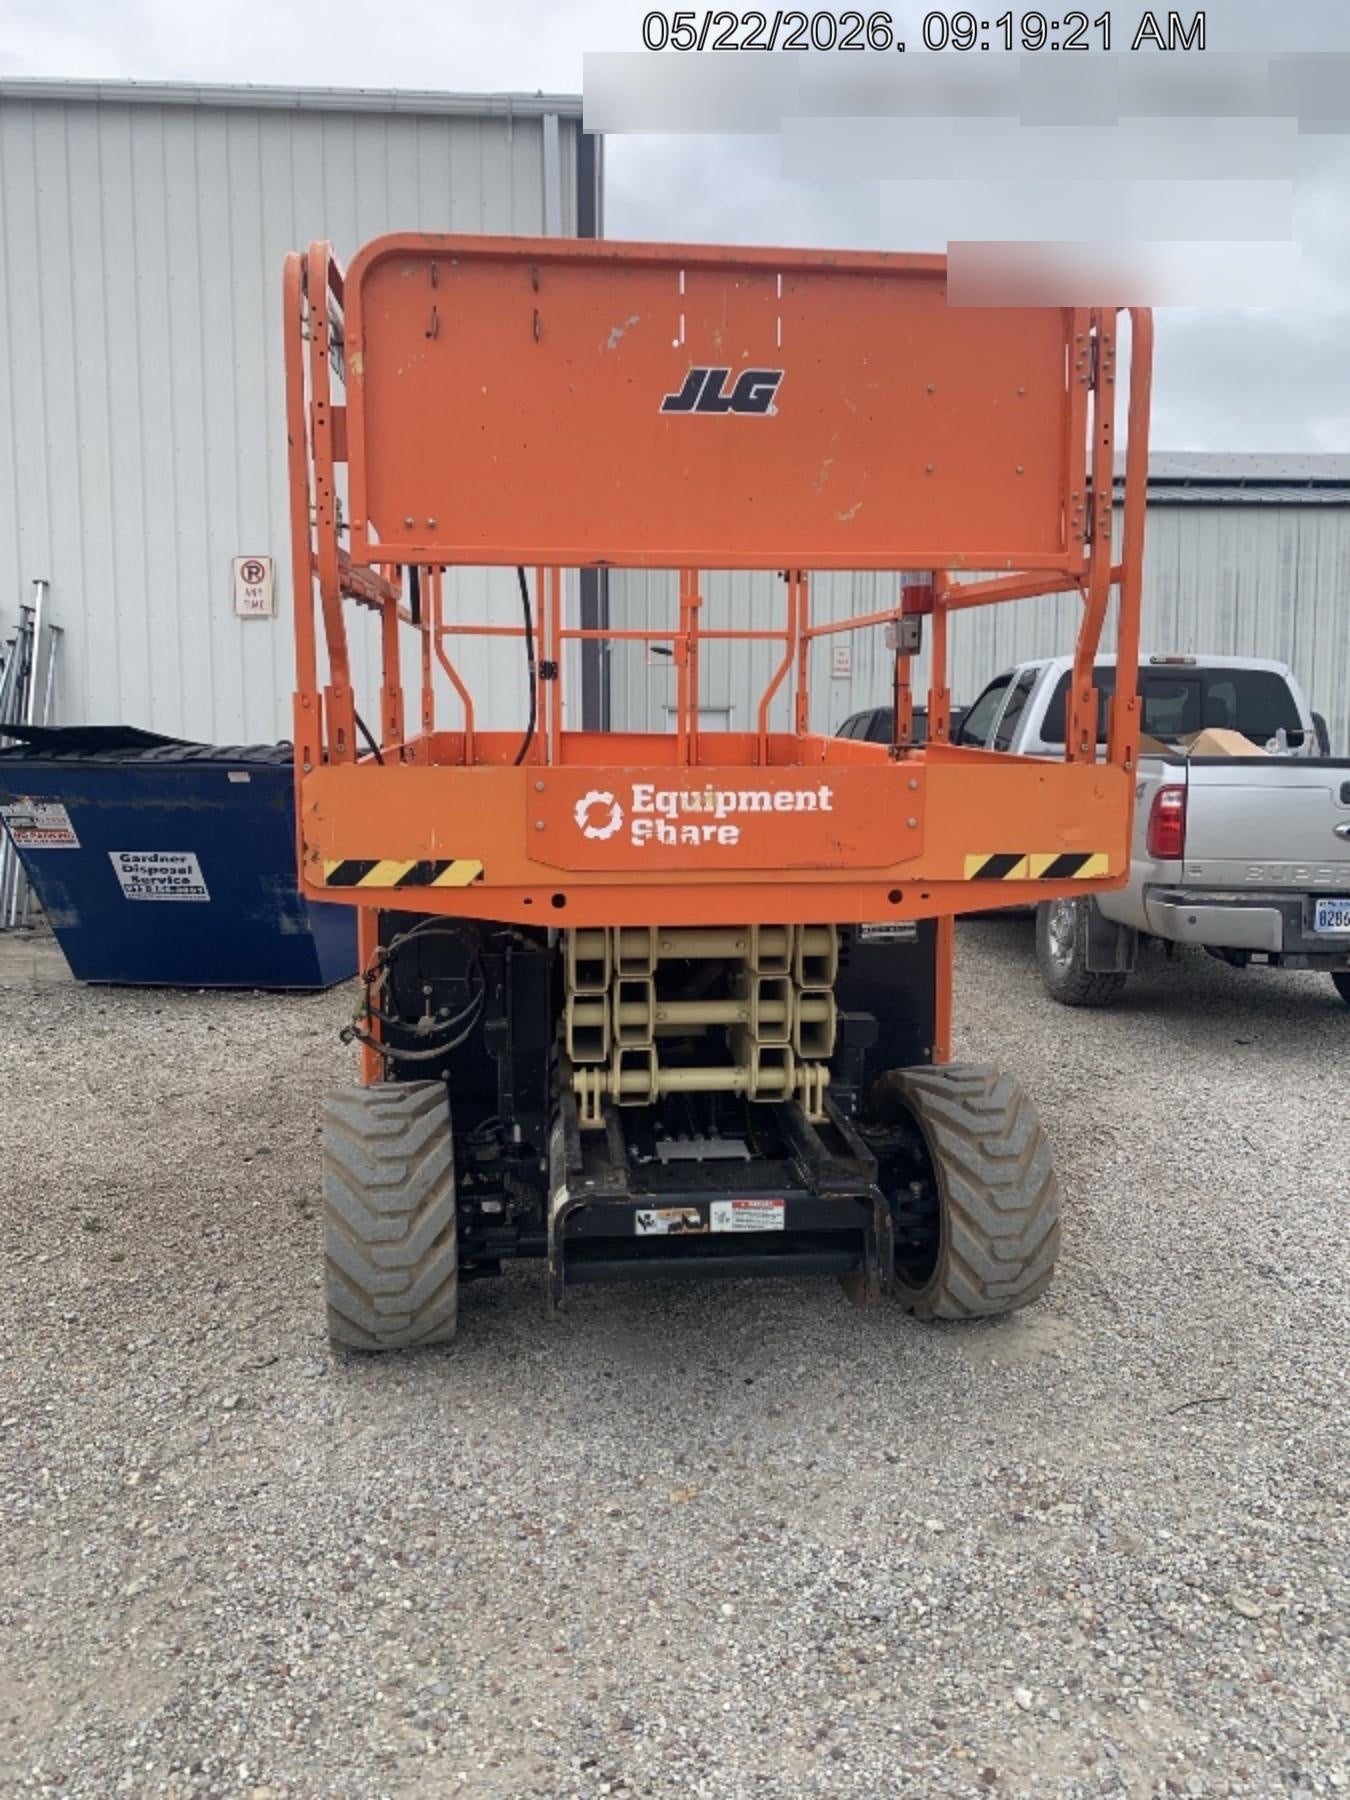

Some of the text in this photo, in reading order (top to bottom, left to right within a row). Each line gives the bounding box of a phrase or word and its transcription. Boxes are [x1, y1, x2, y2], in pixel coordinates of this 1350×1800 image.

[659, 366, 785, 415] JLG
[631, 783, 833, 818] Equipment
[631, 818, 740, 846] Share
[119, 853, 187, 863] Gardner
[122, 864, 193, 876] Disposal
[130, 875, 191, 885] Service
